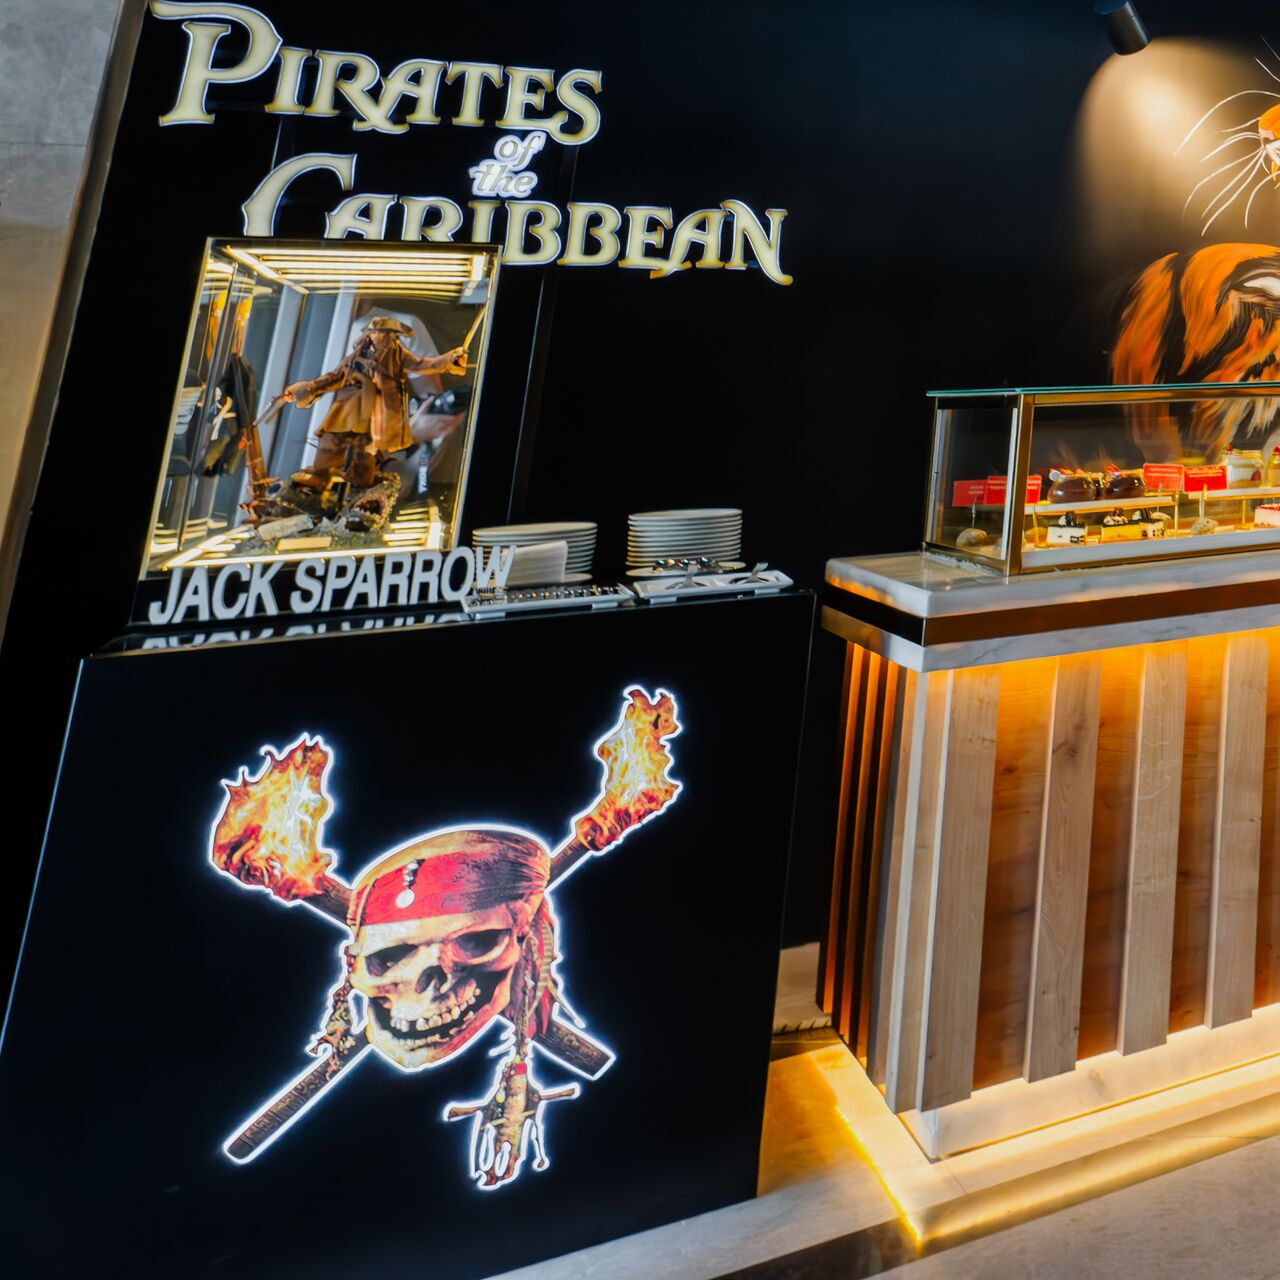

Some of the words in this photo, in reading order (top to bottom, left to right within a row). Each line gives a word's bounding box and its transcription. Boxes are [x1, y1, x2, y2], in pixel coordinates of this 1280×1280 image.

[471, 161, 536, 196] the
[496, 132, 544, 170] of
[242, 152, 794, 285] CARIBBEAN
[148, 561, 284, 625] JACK
[289, 545, 517, 613] SPARROW
